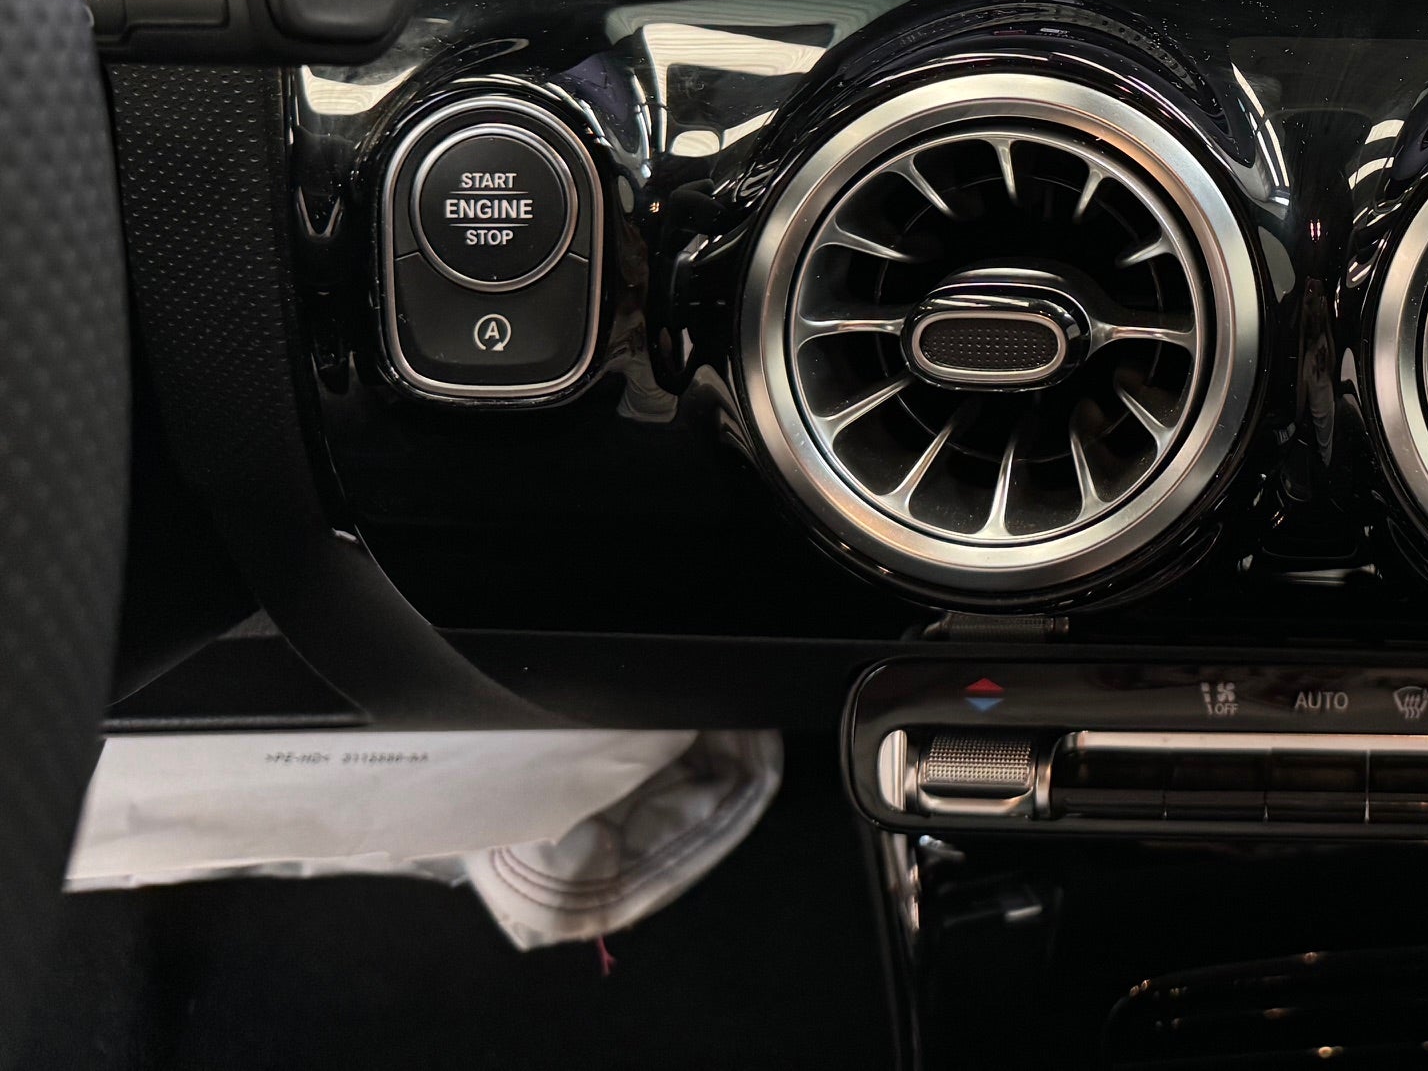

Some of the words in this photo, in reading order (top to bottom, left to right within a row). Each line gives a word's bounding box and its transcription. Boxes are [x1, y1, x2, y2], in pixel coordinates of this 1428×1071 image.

[461, 173, 517, 189] START
[445, 198, 534, 219] ENGINE
[465, 229, 514, 246] STOP
[1214, 703, 1239, 716] OFF
[1294, 691, 1349, 711] AUTO
